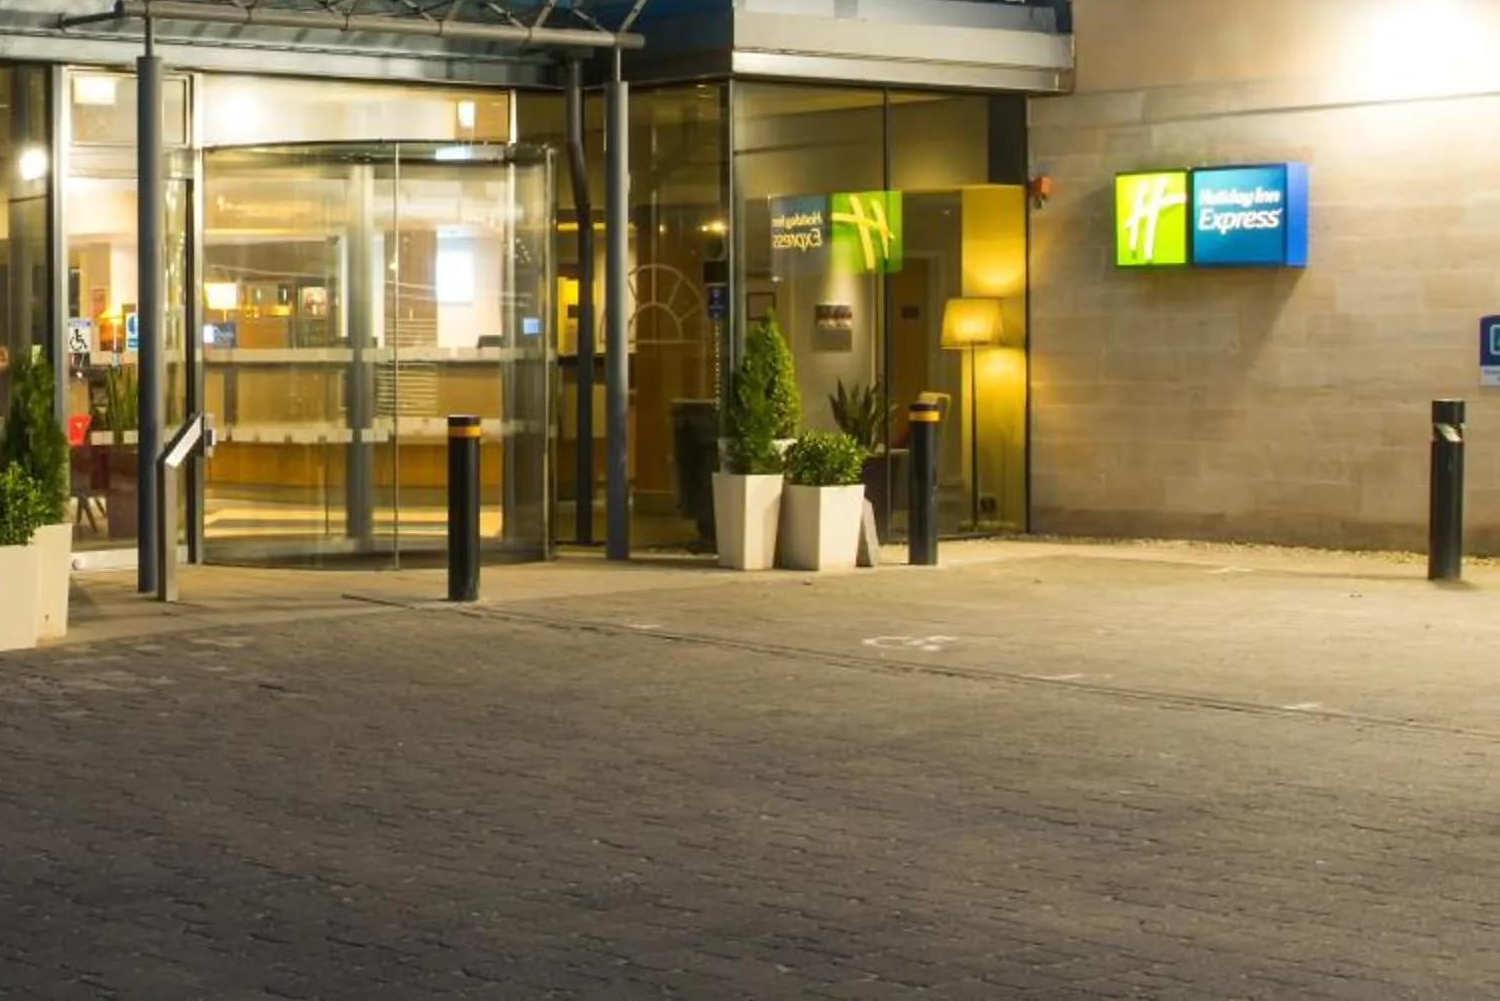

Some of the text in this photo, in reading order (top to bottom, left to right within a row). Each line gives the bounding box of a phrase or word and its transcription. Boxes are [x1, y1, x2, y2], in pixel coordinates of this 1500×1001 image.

[1198, 187, 1280, 207] Holiday Inn
[1198, 208, 1282, 235] Express
